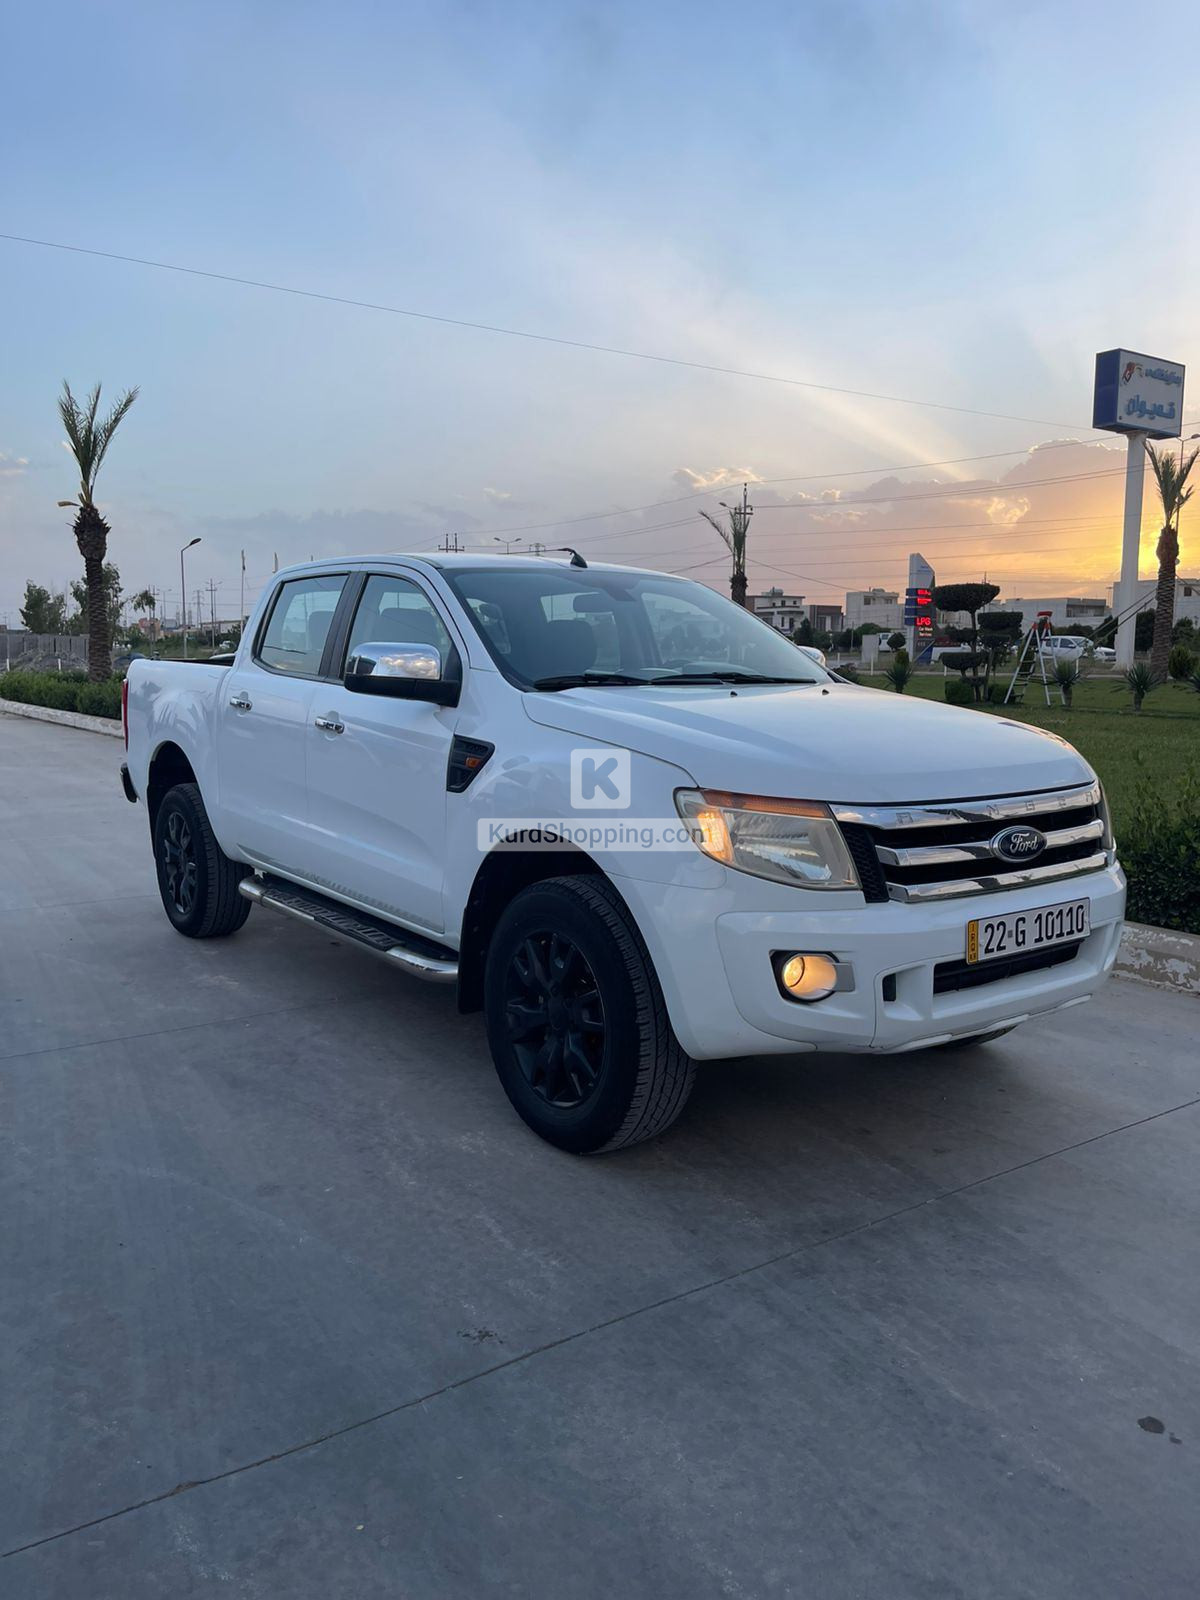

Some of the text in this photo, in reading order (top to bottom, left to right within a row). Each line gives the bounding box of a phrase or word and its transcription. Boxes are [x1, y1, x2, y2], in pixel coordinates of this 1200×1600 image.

[916, 617, 931, 625] LPG
[1010, 832, 1038, 853] Ford
[984, 904, 1085, 954] 22 G 10110
